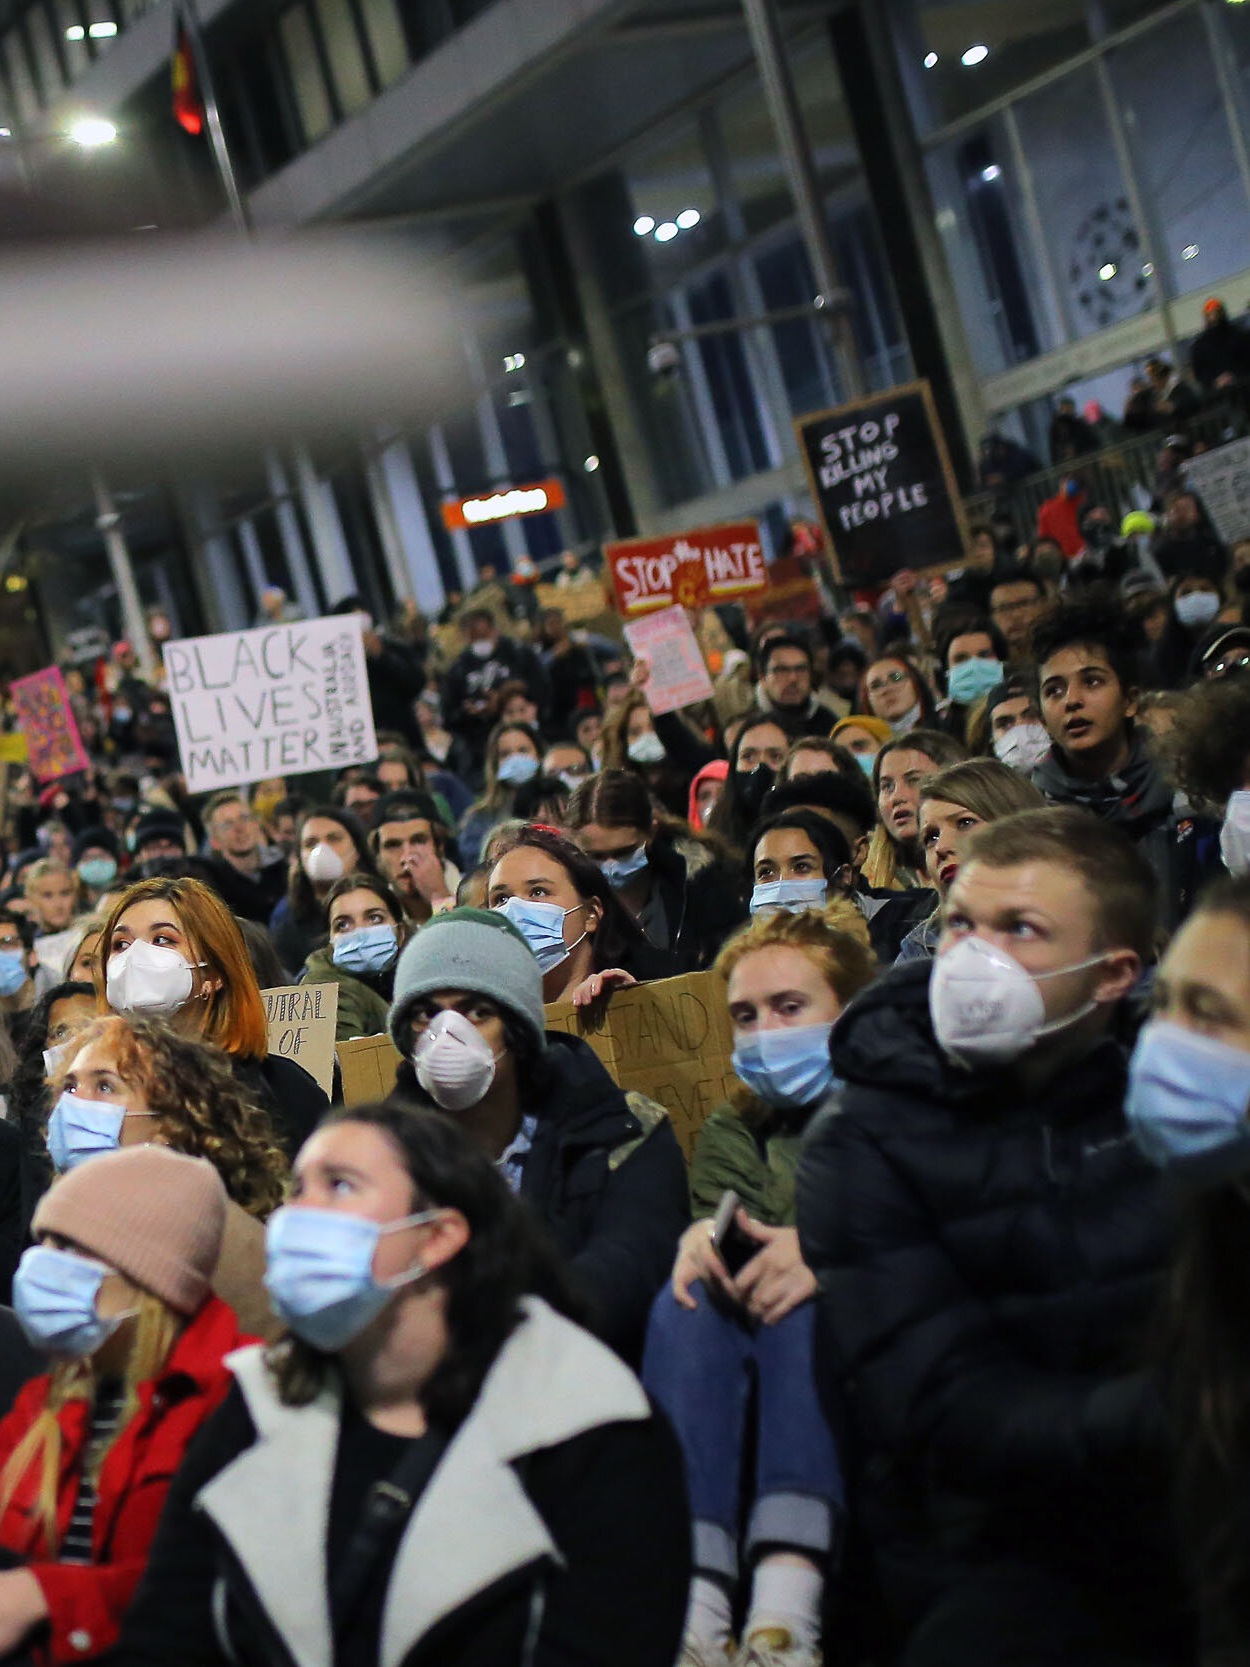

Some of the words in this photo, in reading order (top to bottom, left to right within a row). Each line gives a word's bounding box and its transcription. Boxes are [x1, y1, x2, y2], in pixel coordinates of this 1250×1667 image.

[821, 412, 900, 463] STOP
[853, 465, 887, 498] MY
[839, 483, 928, 531] PEOPLE
[616, 554, 678, 600] STOP
[704, 543, 764, 581] HATE
[168, 630, 316, 694] BLACK
[182, 682, 323, 743] LIVES
[189, 728, 326, 778] MATTER
[264, 990, 327, 1023] UTRAL
[278, 1027, 309, 1055] OF
